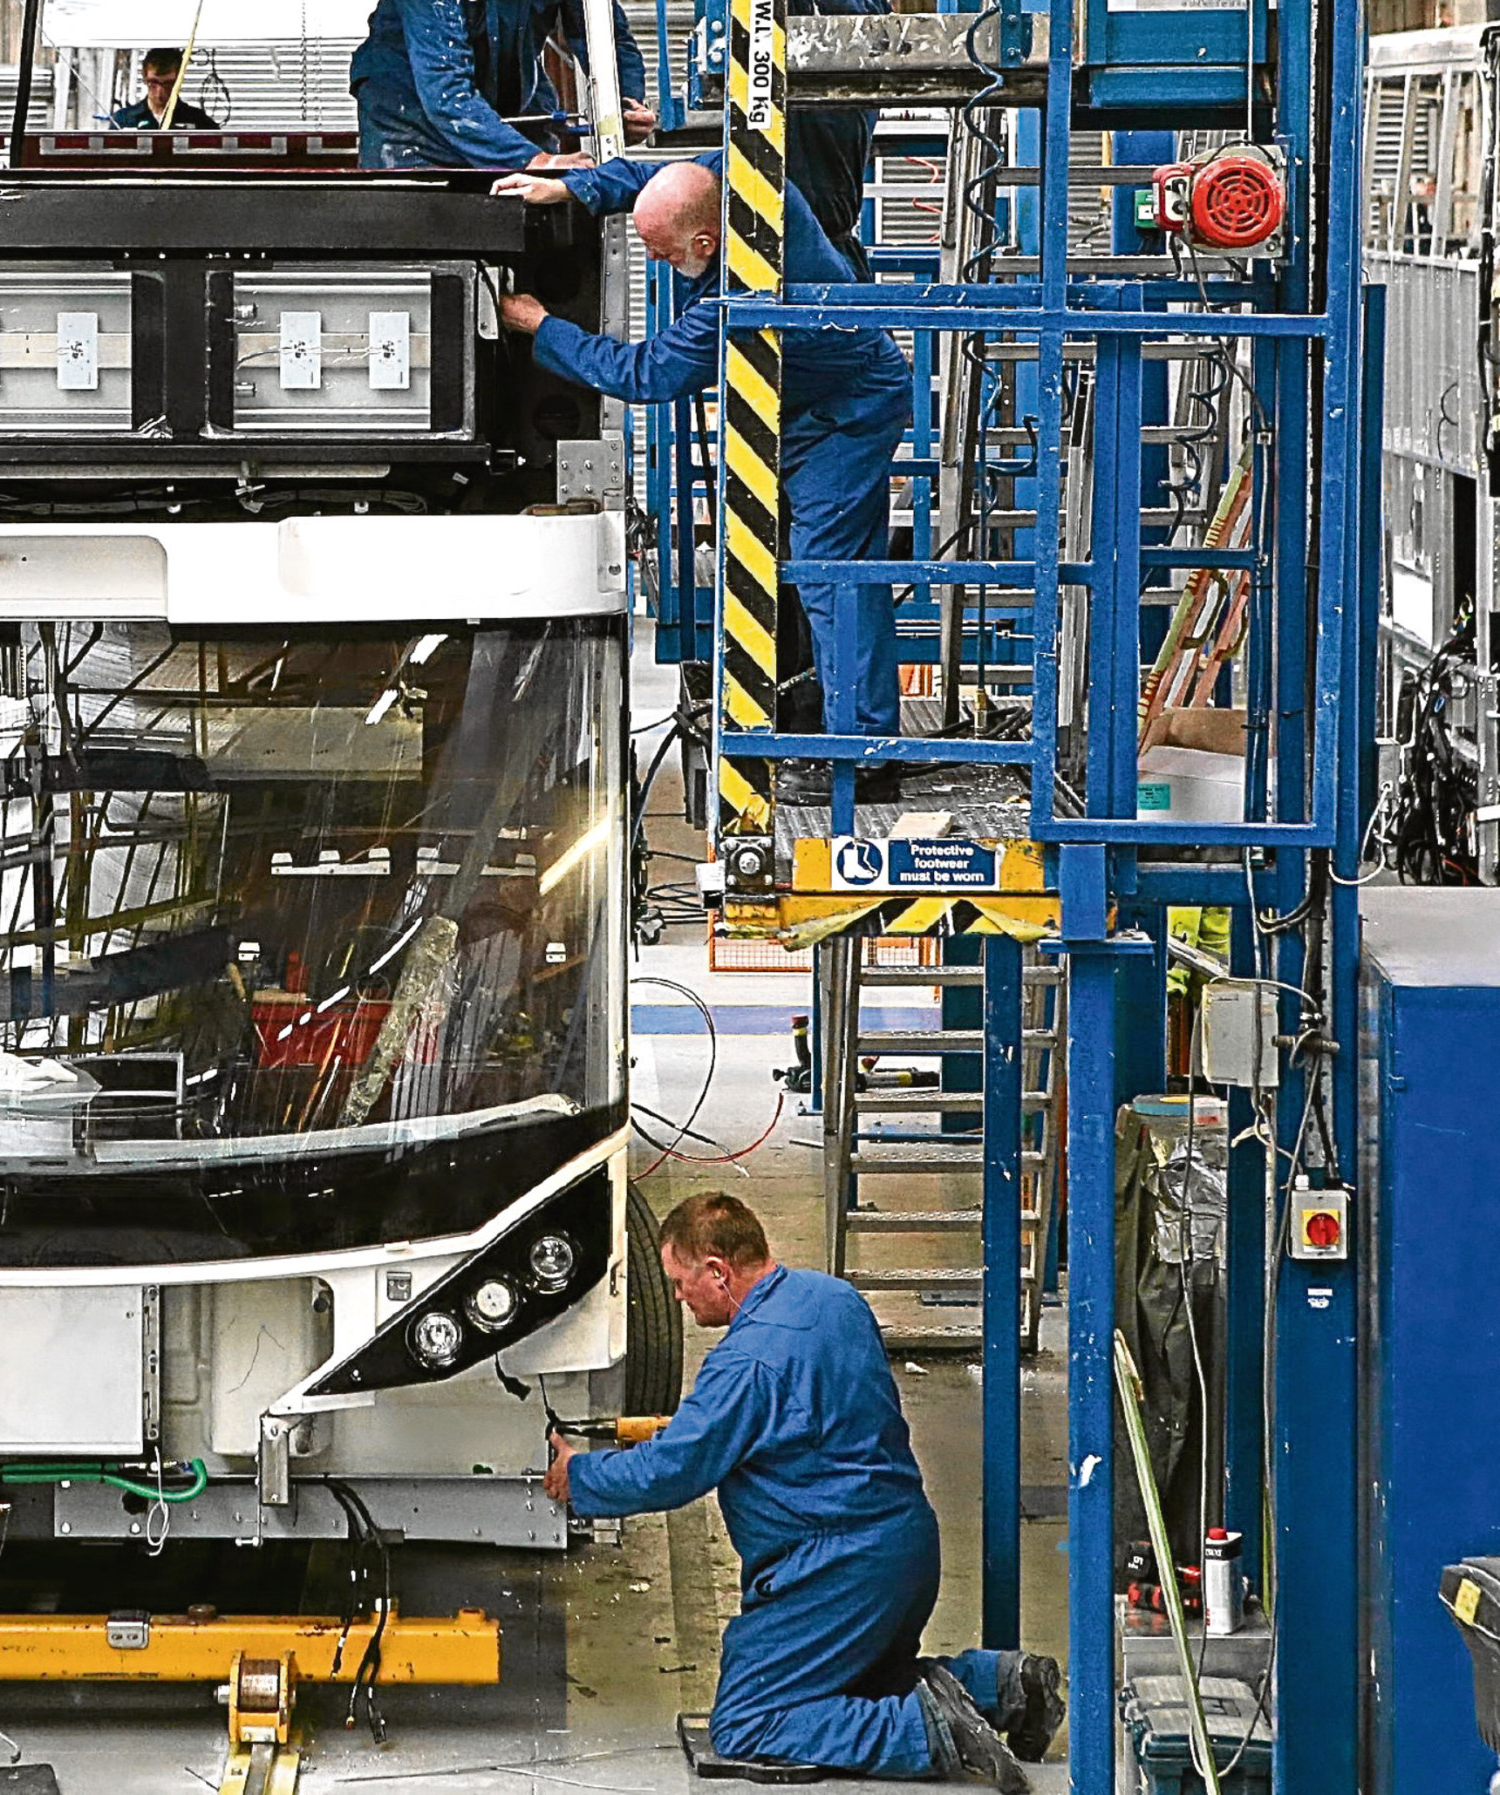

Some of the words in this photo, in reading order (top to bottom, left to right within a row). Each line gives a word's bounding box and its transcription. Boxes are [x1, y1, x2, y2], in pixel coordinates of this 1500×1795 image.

[753, 51, 771, 88] 300
[910, 844, 974, 856] Protective
[914, 858, 970, 869] footwear
[900, 872, 931, 882] must
[934, 871, 950, 882] be
[952, 873, 985, 882] worn
